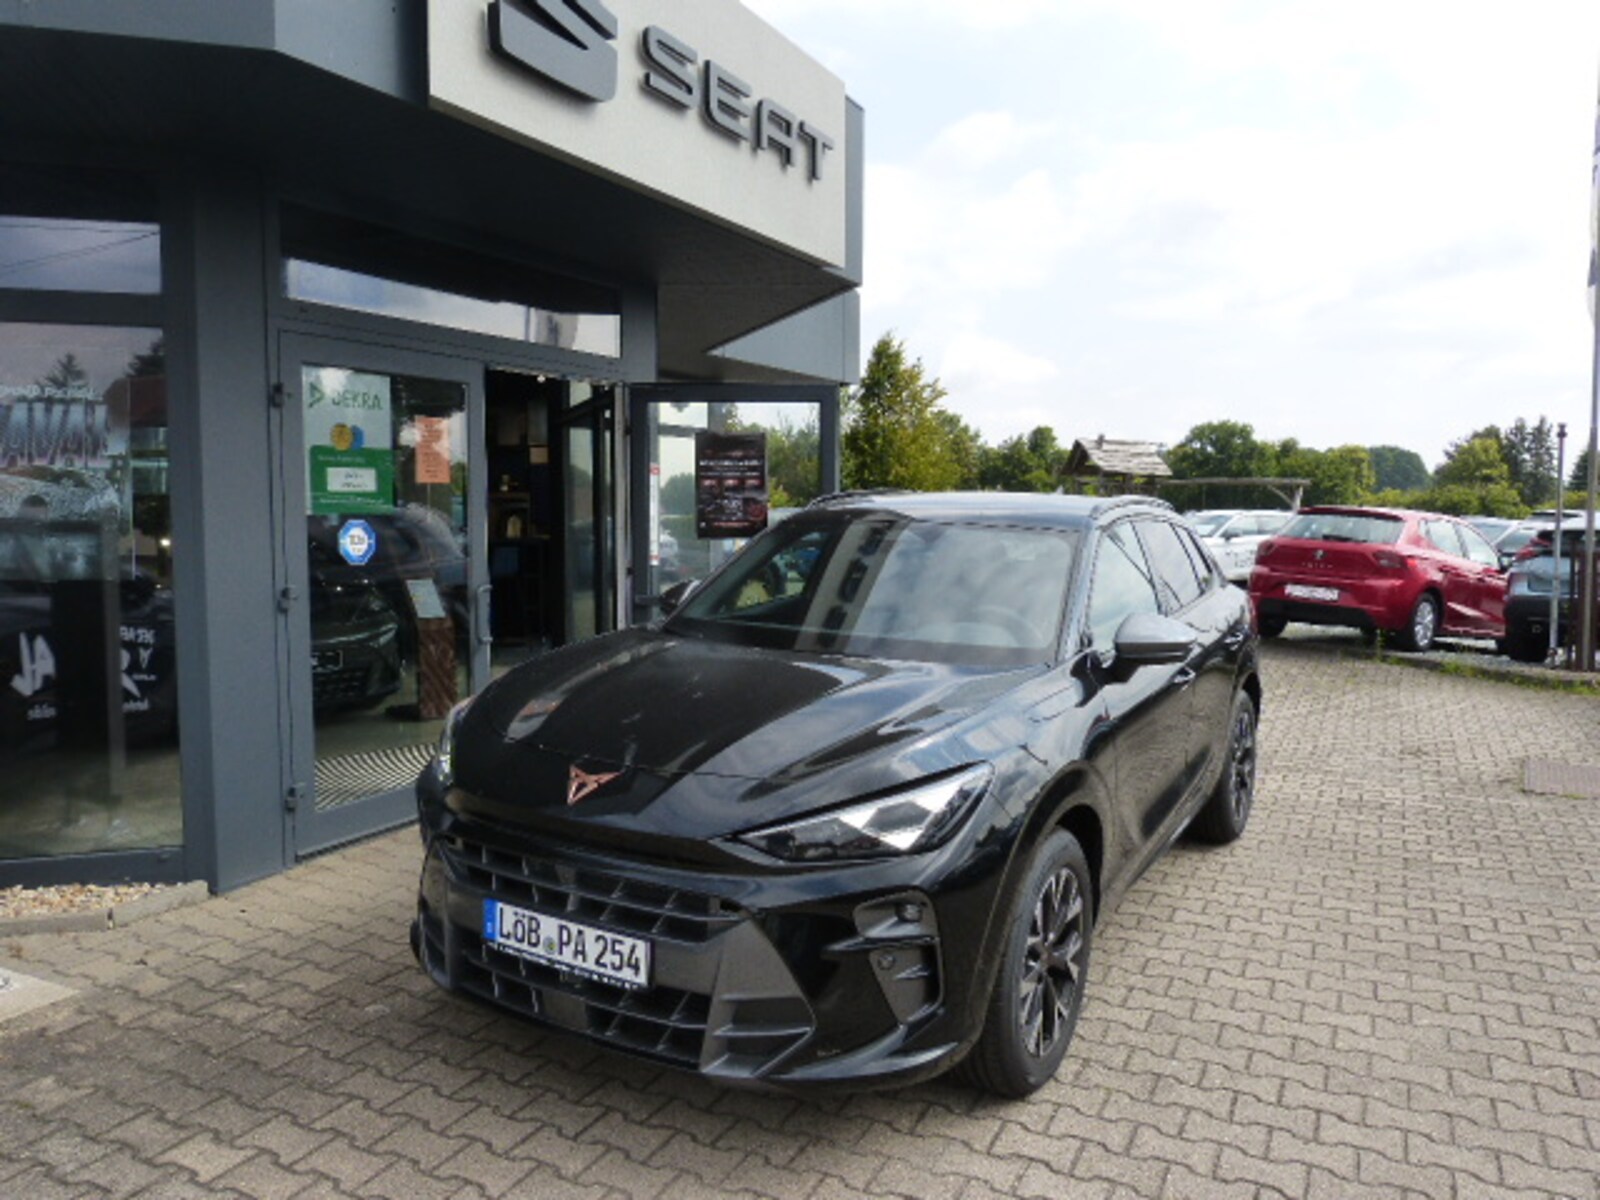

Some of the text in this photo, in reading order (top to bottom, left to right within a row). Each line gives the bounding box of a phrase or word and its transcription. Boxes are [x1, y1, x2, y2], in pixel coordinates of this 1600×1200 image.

[640, 25, 834, 182] SEAT
[557, 924, 588, 964] PA
[594, 934, 641, 977] 254
